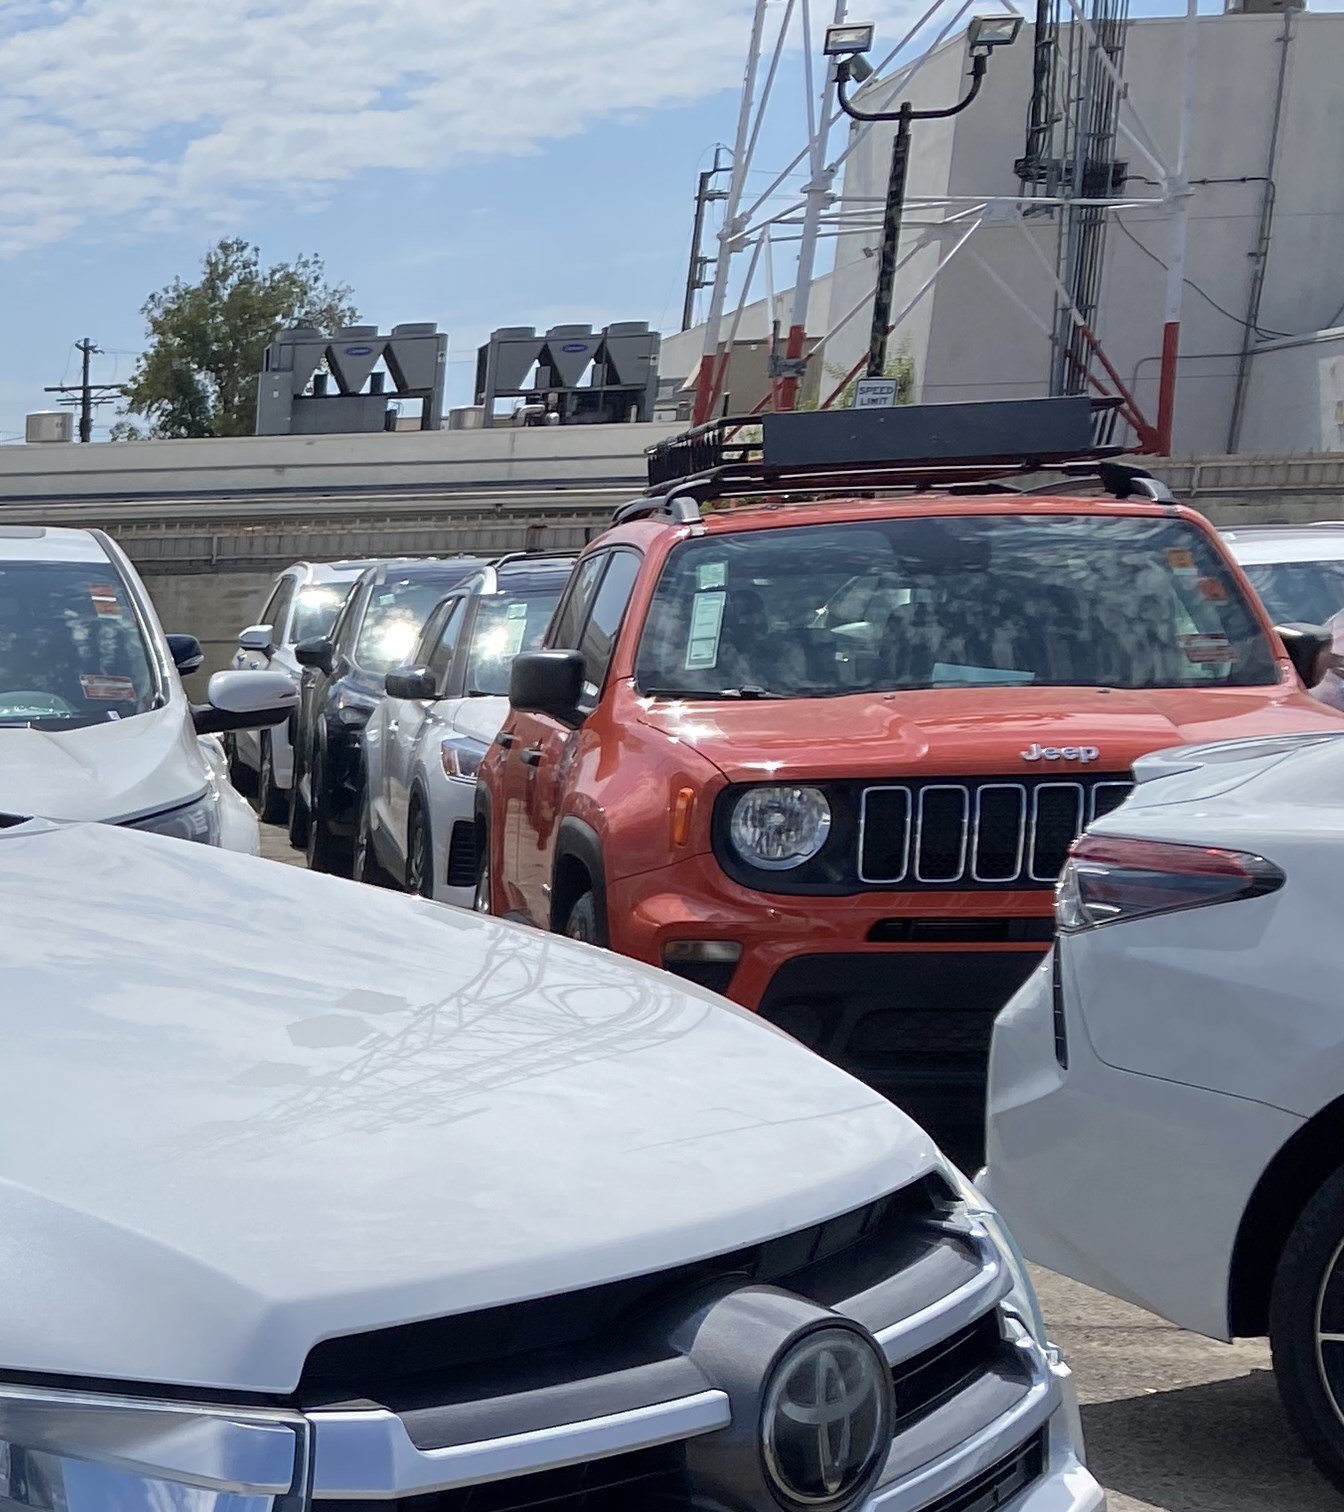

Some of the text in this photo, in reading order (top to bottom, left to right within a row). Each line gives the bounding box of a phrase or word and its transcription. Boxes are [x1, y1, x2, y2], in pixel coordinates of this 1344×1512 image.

[859, 386, 894, 394] SPEED
[861, 397, 888, 405] LIMIT
[1020, 744, 1099, 763] Jeep
